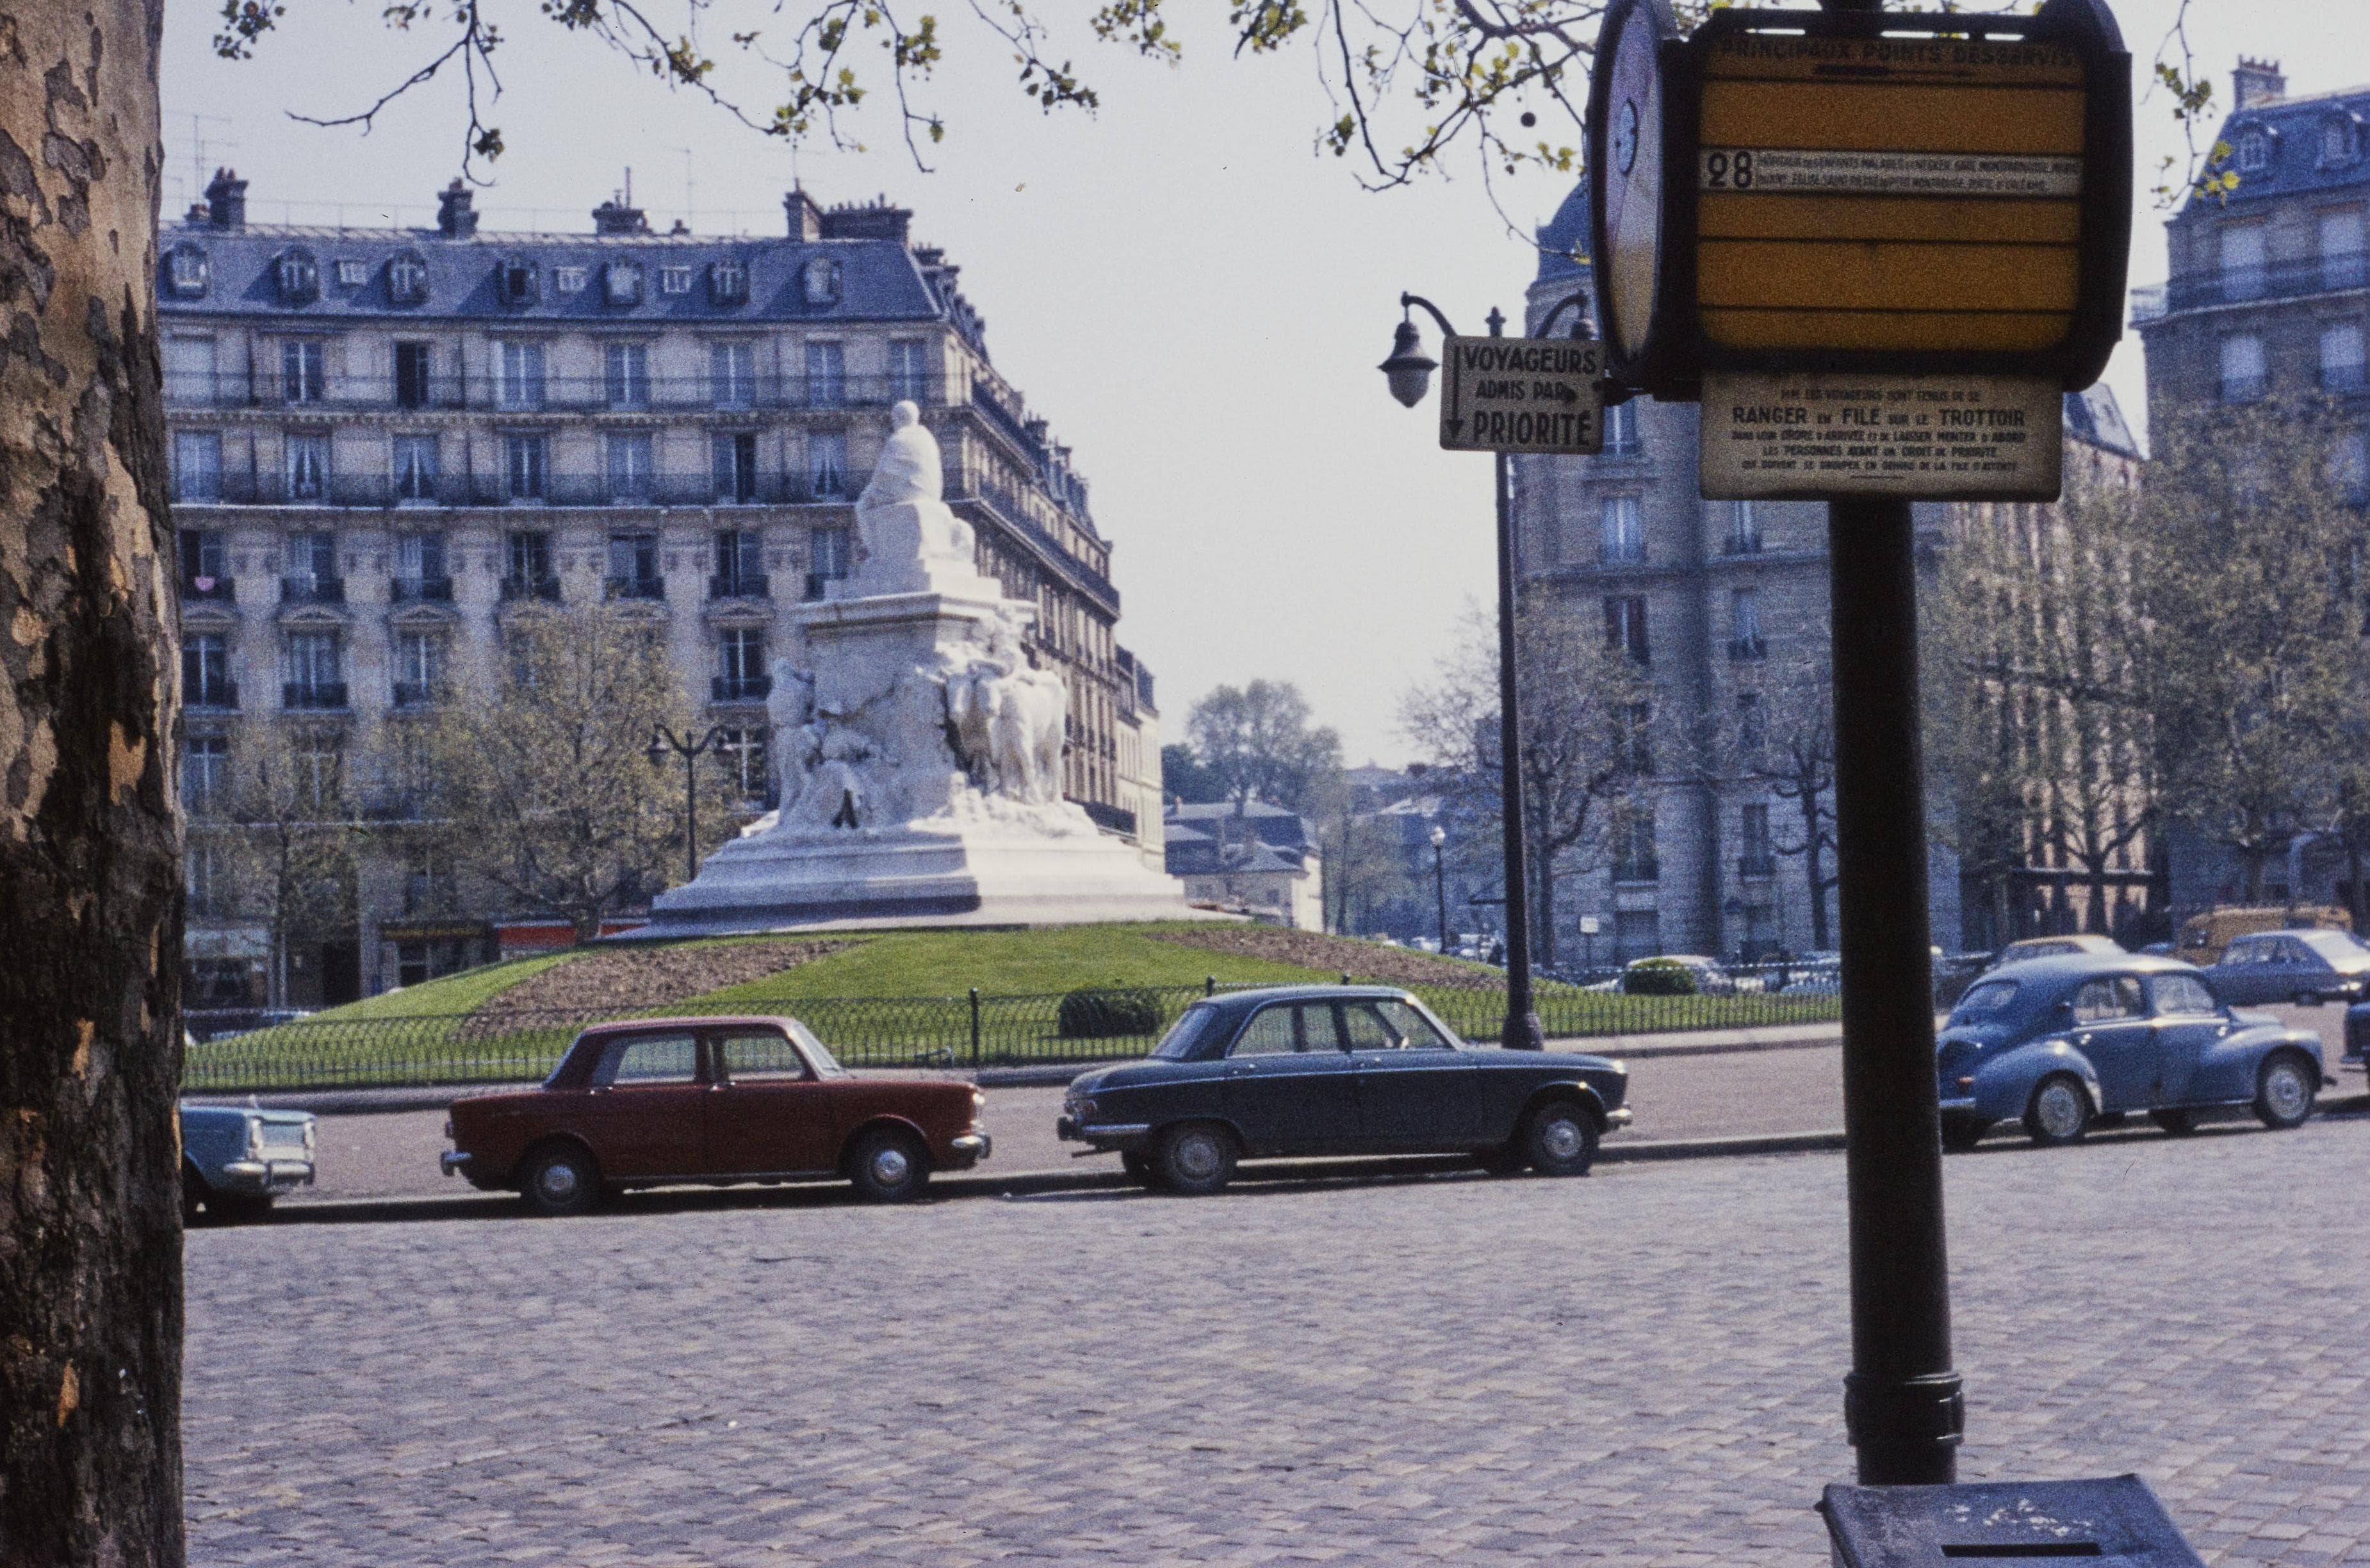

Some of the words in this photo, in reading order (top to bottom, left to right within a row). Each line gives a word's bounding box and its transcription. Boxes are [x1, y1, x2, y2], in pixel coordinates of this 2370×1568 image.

[1708, 151, 1752, 188] 28
[1464, 345, 1597, 374] VOYAGEURS
[1476, 380, 1525, 400] ADMIS
[1533, 381, 1567, 401] PAR
[1473, 409, 1591, 446] PRIORITÉ
[1732, 407, 1807, 425] RANGER
[1842, 407, 1881, 425] FILE
[1938, 409, 2024, 426] TROTTOIR
